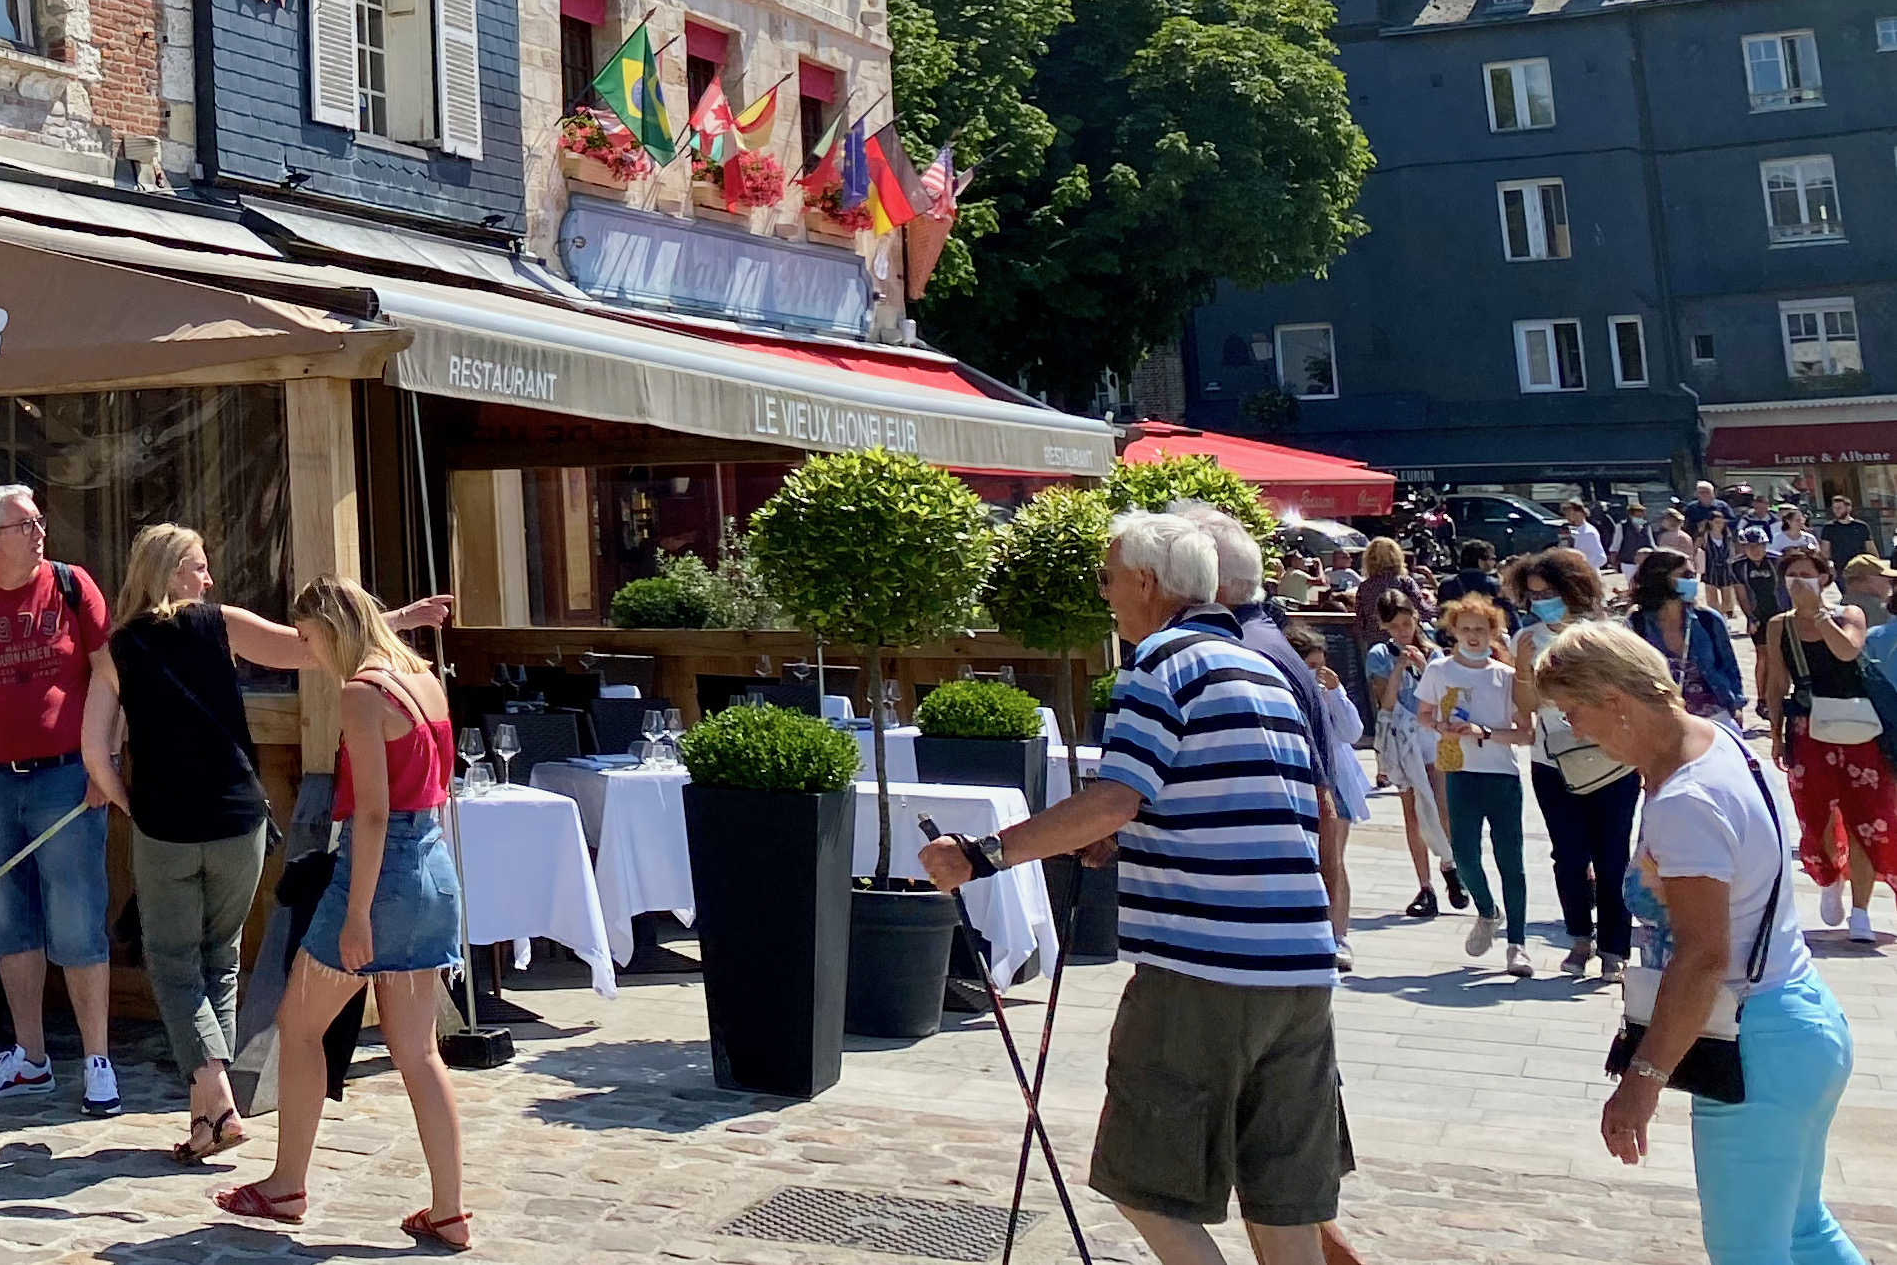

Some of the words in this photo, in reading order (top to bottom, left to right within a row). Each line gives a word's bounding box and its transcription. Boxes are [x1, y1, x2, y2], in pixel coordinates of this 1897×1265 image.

[449, 354, 558, 401] RESTAURANT
[755, 394, 779, 435] LE
[780, 398, 833, 444] VIEUX
